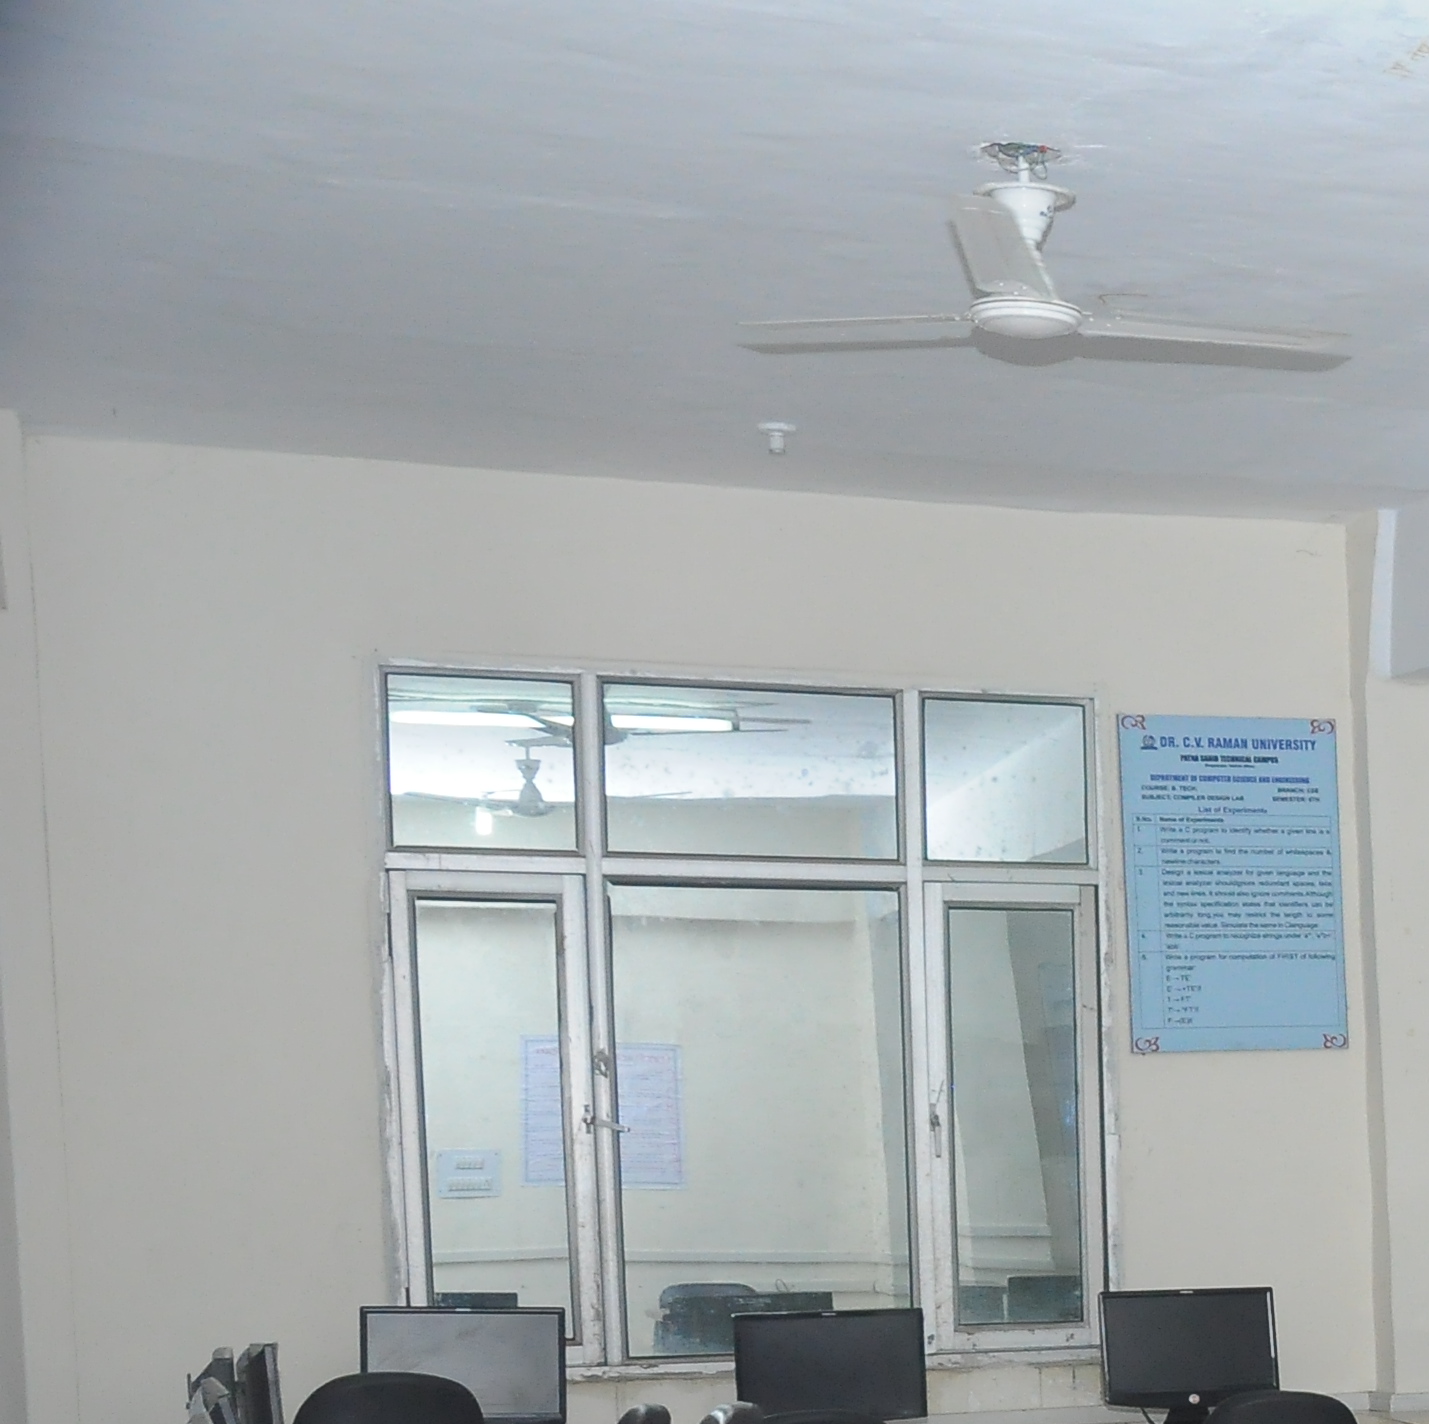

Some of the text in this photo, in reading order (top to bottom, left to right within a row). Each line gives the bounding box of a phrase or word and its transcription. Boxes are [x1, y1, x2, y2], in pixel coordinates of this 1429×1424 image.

[1160, 736, 1317, 751] DR. C.V. RAMAN UNIVERSITY
[1199, 775, 1231, 783] COMPUTER
[1223, 807, 1267, 815] Experiments
